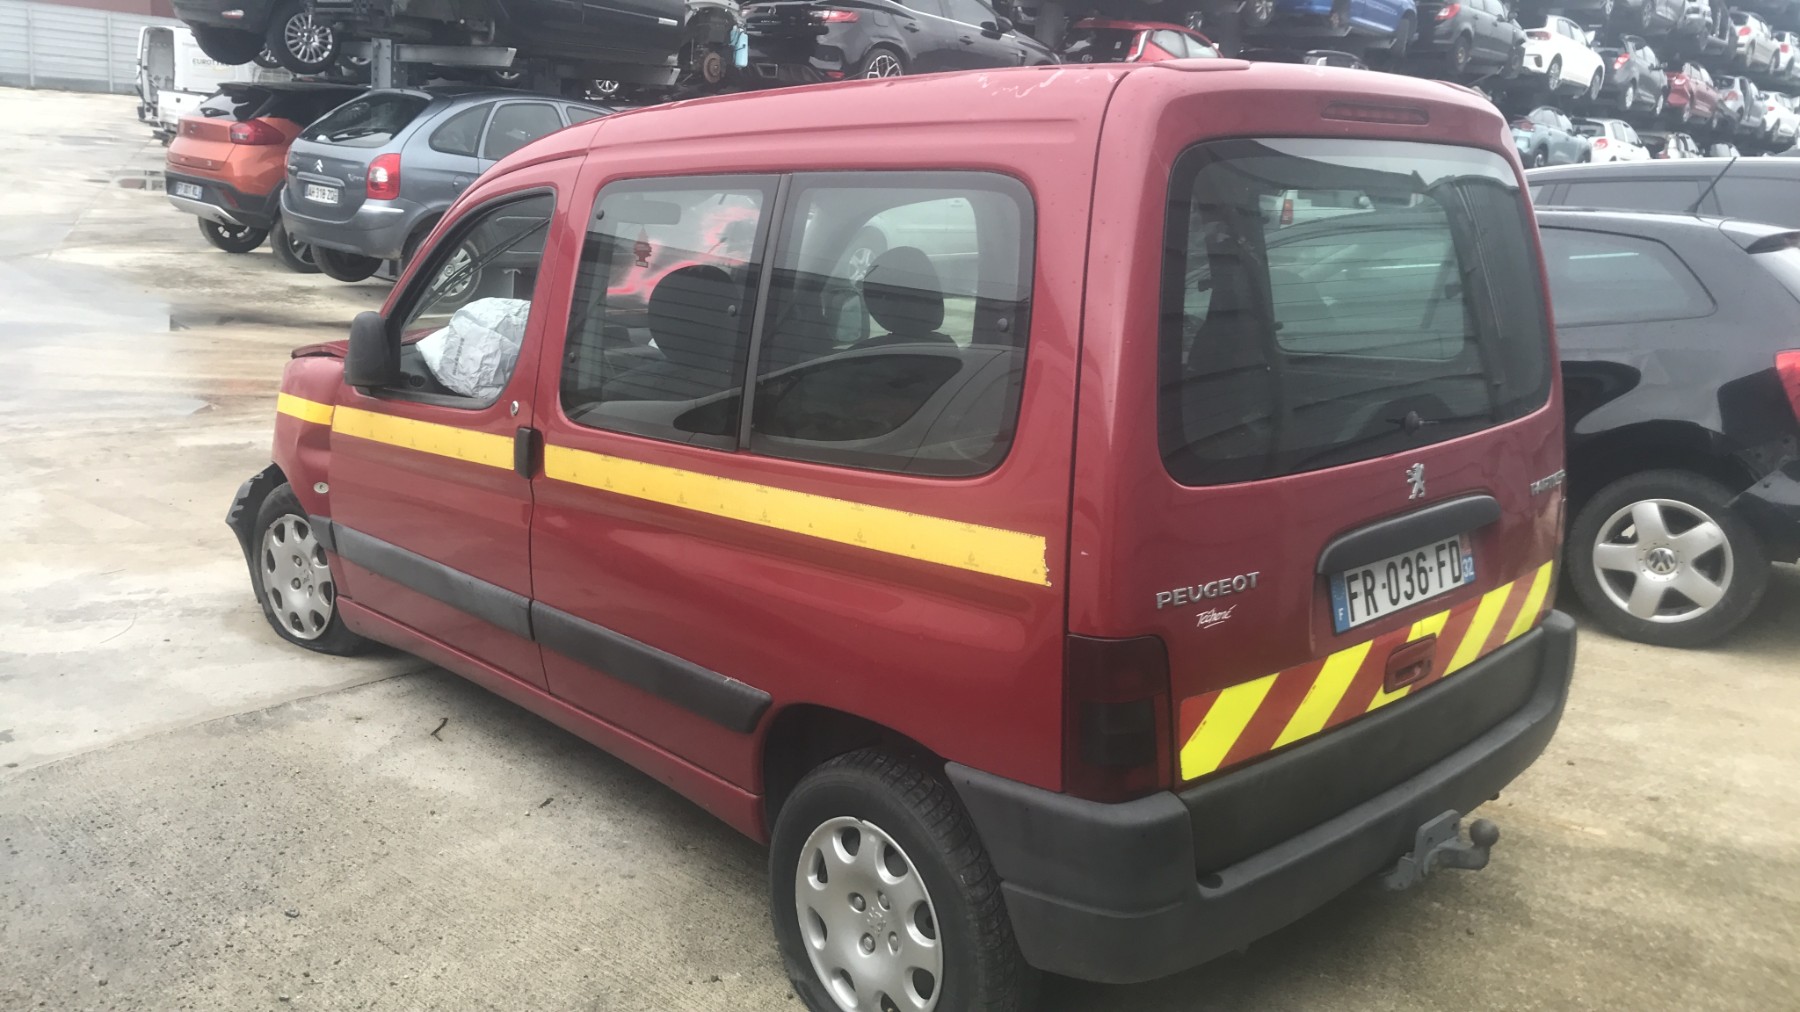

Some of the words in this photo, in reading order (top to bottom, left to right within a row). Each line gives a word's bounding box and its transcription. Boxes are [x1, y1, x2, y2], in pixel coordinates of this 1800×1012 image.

[1345, 539, 1462, 623] FR-036-FD
[1461, 555, 1475, 578] 32
[1155, 571, 1260, 609] PEUGEOT
